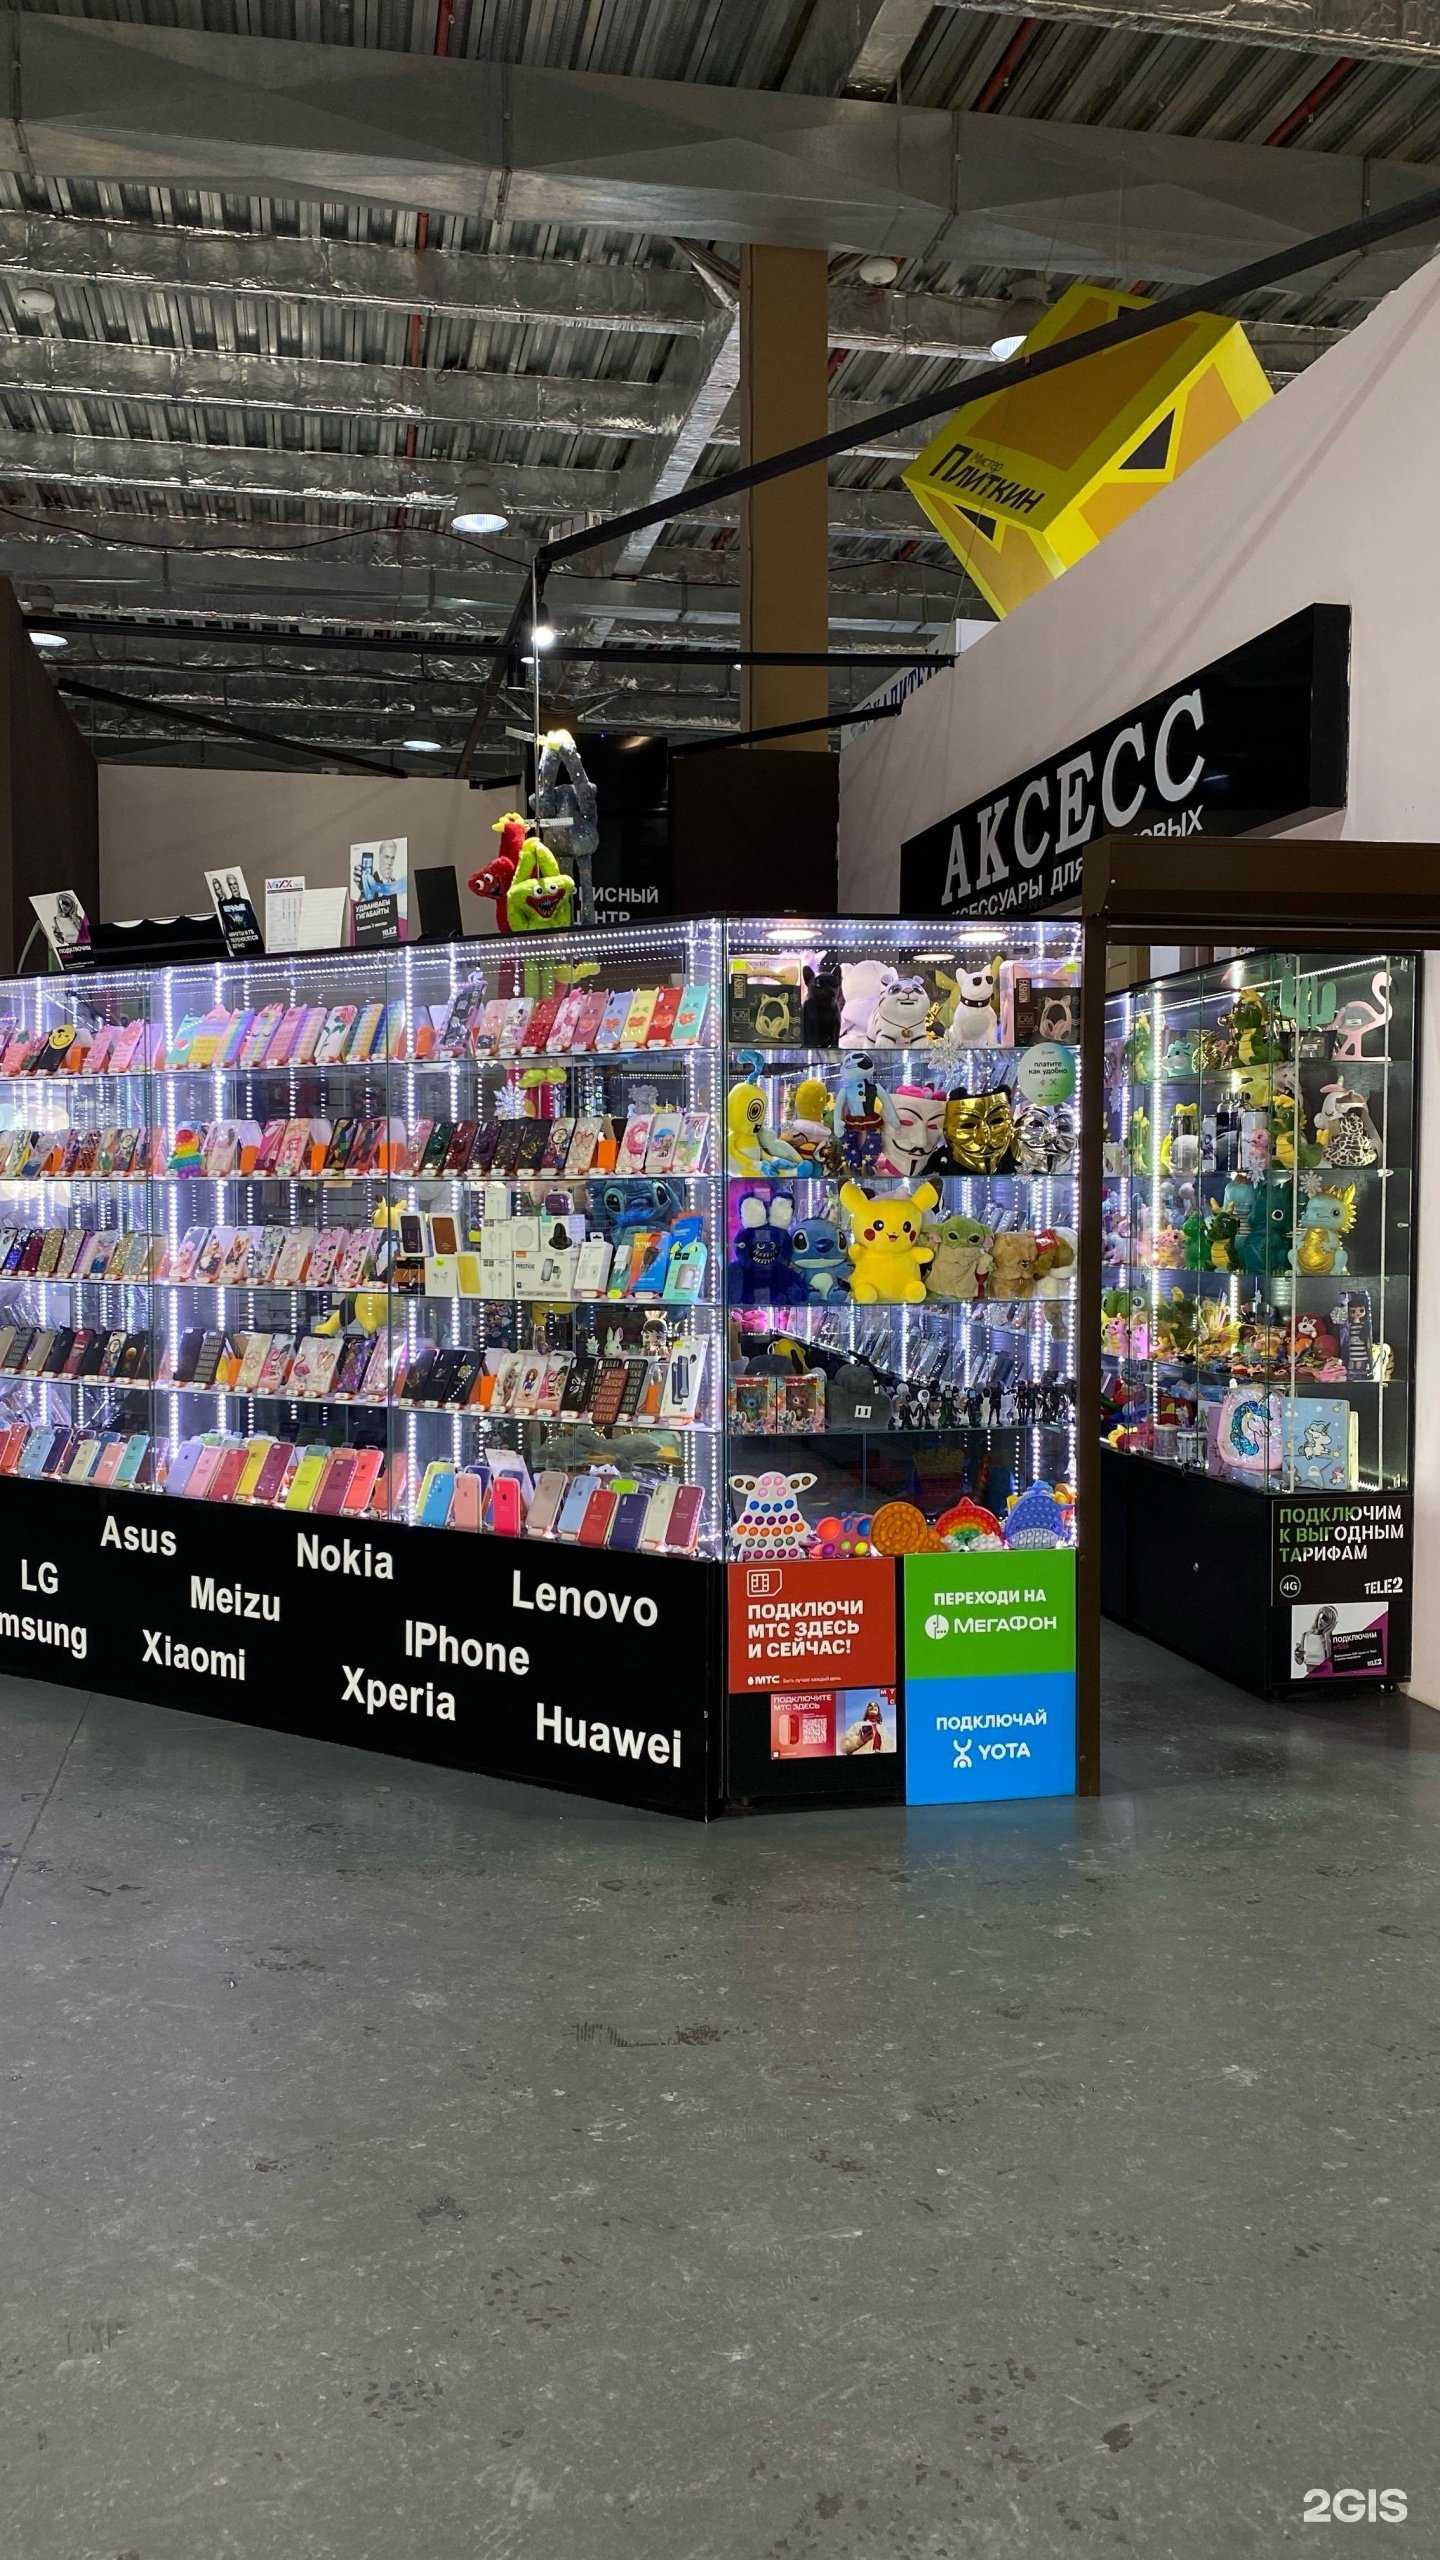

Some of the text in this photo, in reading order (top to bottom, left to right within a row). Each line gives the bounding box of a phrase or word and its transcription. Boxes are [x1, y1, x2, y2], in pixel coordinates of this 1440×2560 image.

[941, 688, 1205, 906] АКСЕСС
[952, 874, 1042, 915] ЕССУАРЫ
[1280, 1504, 1402, 1526] ПОДКЛЮЧИМ
[100, 1515, 177, 1556] Asus
[1280, 1524, 1404, 1543] К ВЫГОДНЫМ
[297, 1533, 394, 1580] Nokia
[1280, 1545, 1368, 1563] ТАРИФАМ
[21, 1559, 59, 1594] LG
[1283, 1581, 1298, 1592] 4G
[1364, 1577, 1403, 1595] TELE2
[190, 1575, 280, 1622] Meizu
[512, 1570, 659, 1628] Lenovo
[934, 1589, 1047, 1606] ПЕРЕХОДИ НА
[747, 1600, 864, 1621] ПОДКЛЮЧИ
[0, 1611, 87, 1659] msung
[748, 1620, 860, 1639] МТС ЗДЕСЬ
[1332, 1631, 1378, 1644] ПОДКЛЮЧИМ
[142, 1629, 246, 1681] Xiaomi
[405, 1619, 530, 1676] IPhone
[748, 1638, 851, 1659] И СЕЙЧАС!
[755, 1675, 780, 1685] МТС
[341, 1665, 456, 1722] Xperia
[773, 1694, 832, 1704] ПОДКЛЮЧИТЕ
[774, 1703, 820, 1711] МТС ЗДЕСЬ
[936, 1708, 1048, 1732] ПОДКЛЮЧАЙ
[536, 1702, 681, 1768] Huawei
[978, 1742, 1031, 1760] YOTA
